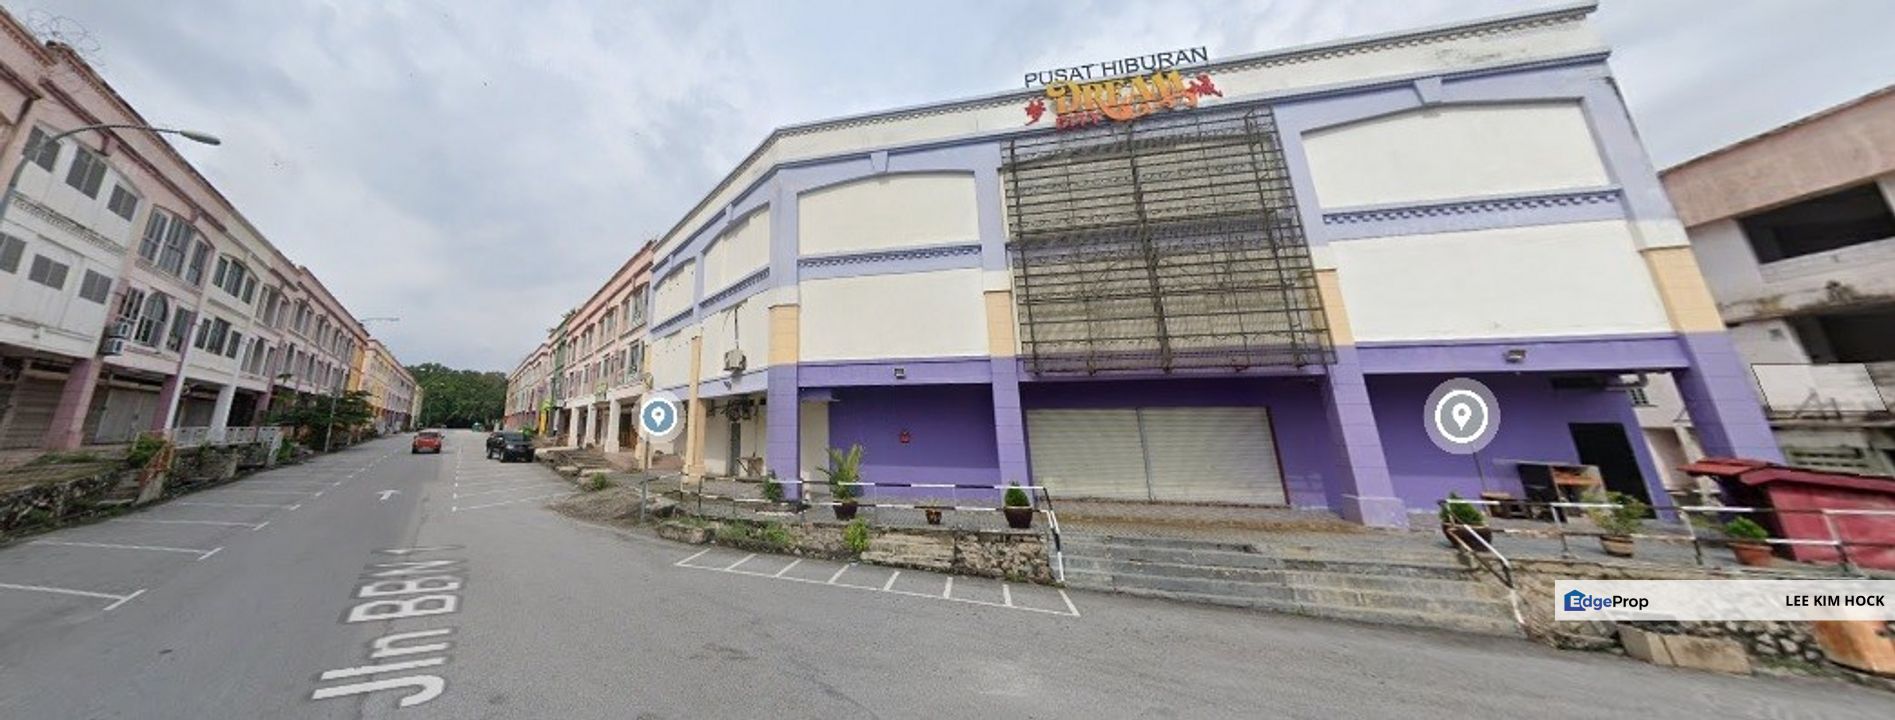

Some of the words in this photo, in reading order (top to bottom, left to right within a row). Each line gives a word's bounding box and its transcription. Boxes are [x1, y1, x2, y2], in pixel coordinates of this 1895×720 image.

[1024, 62, 1095, 87] PUSAT
[1101, 46, 1208, 77] HIBURAN
[1046, 70, 1187, 116] DREAM
